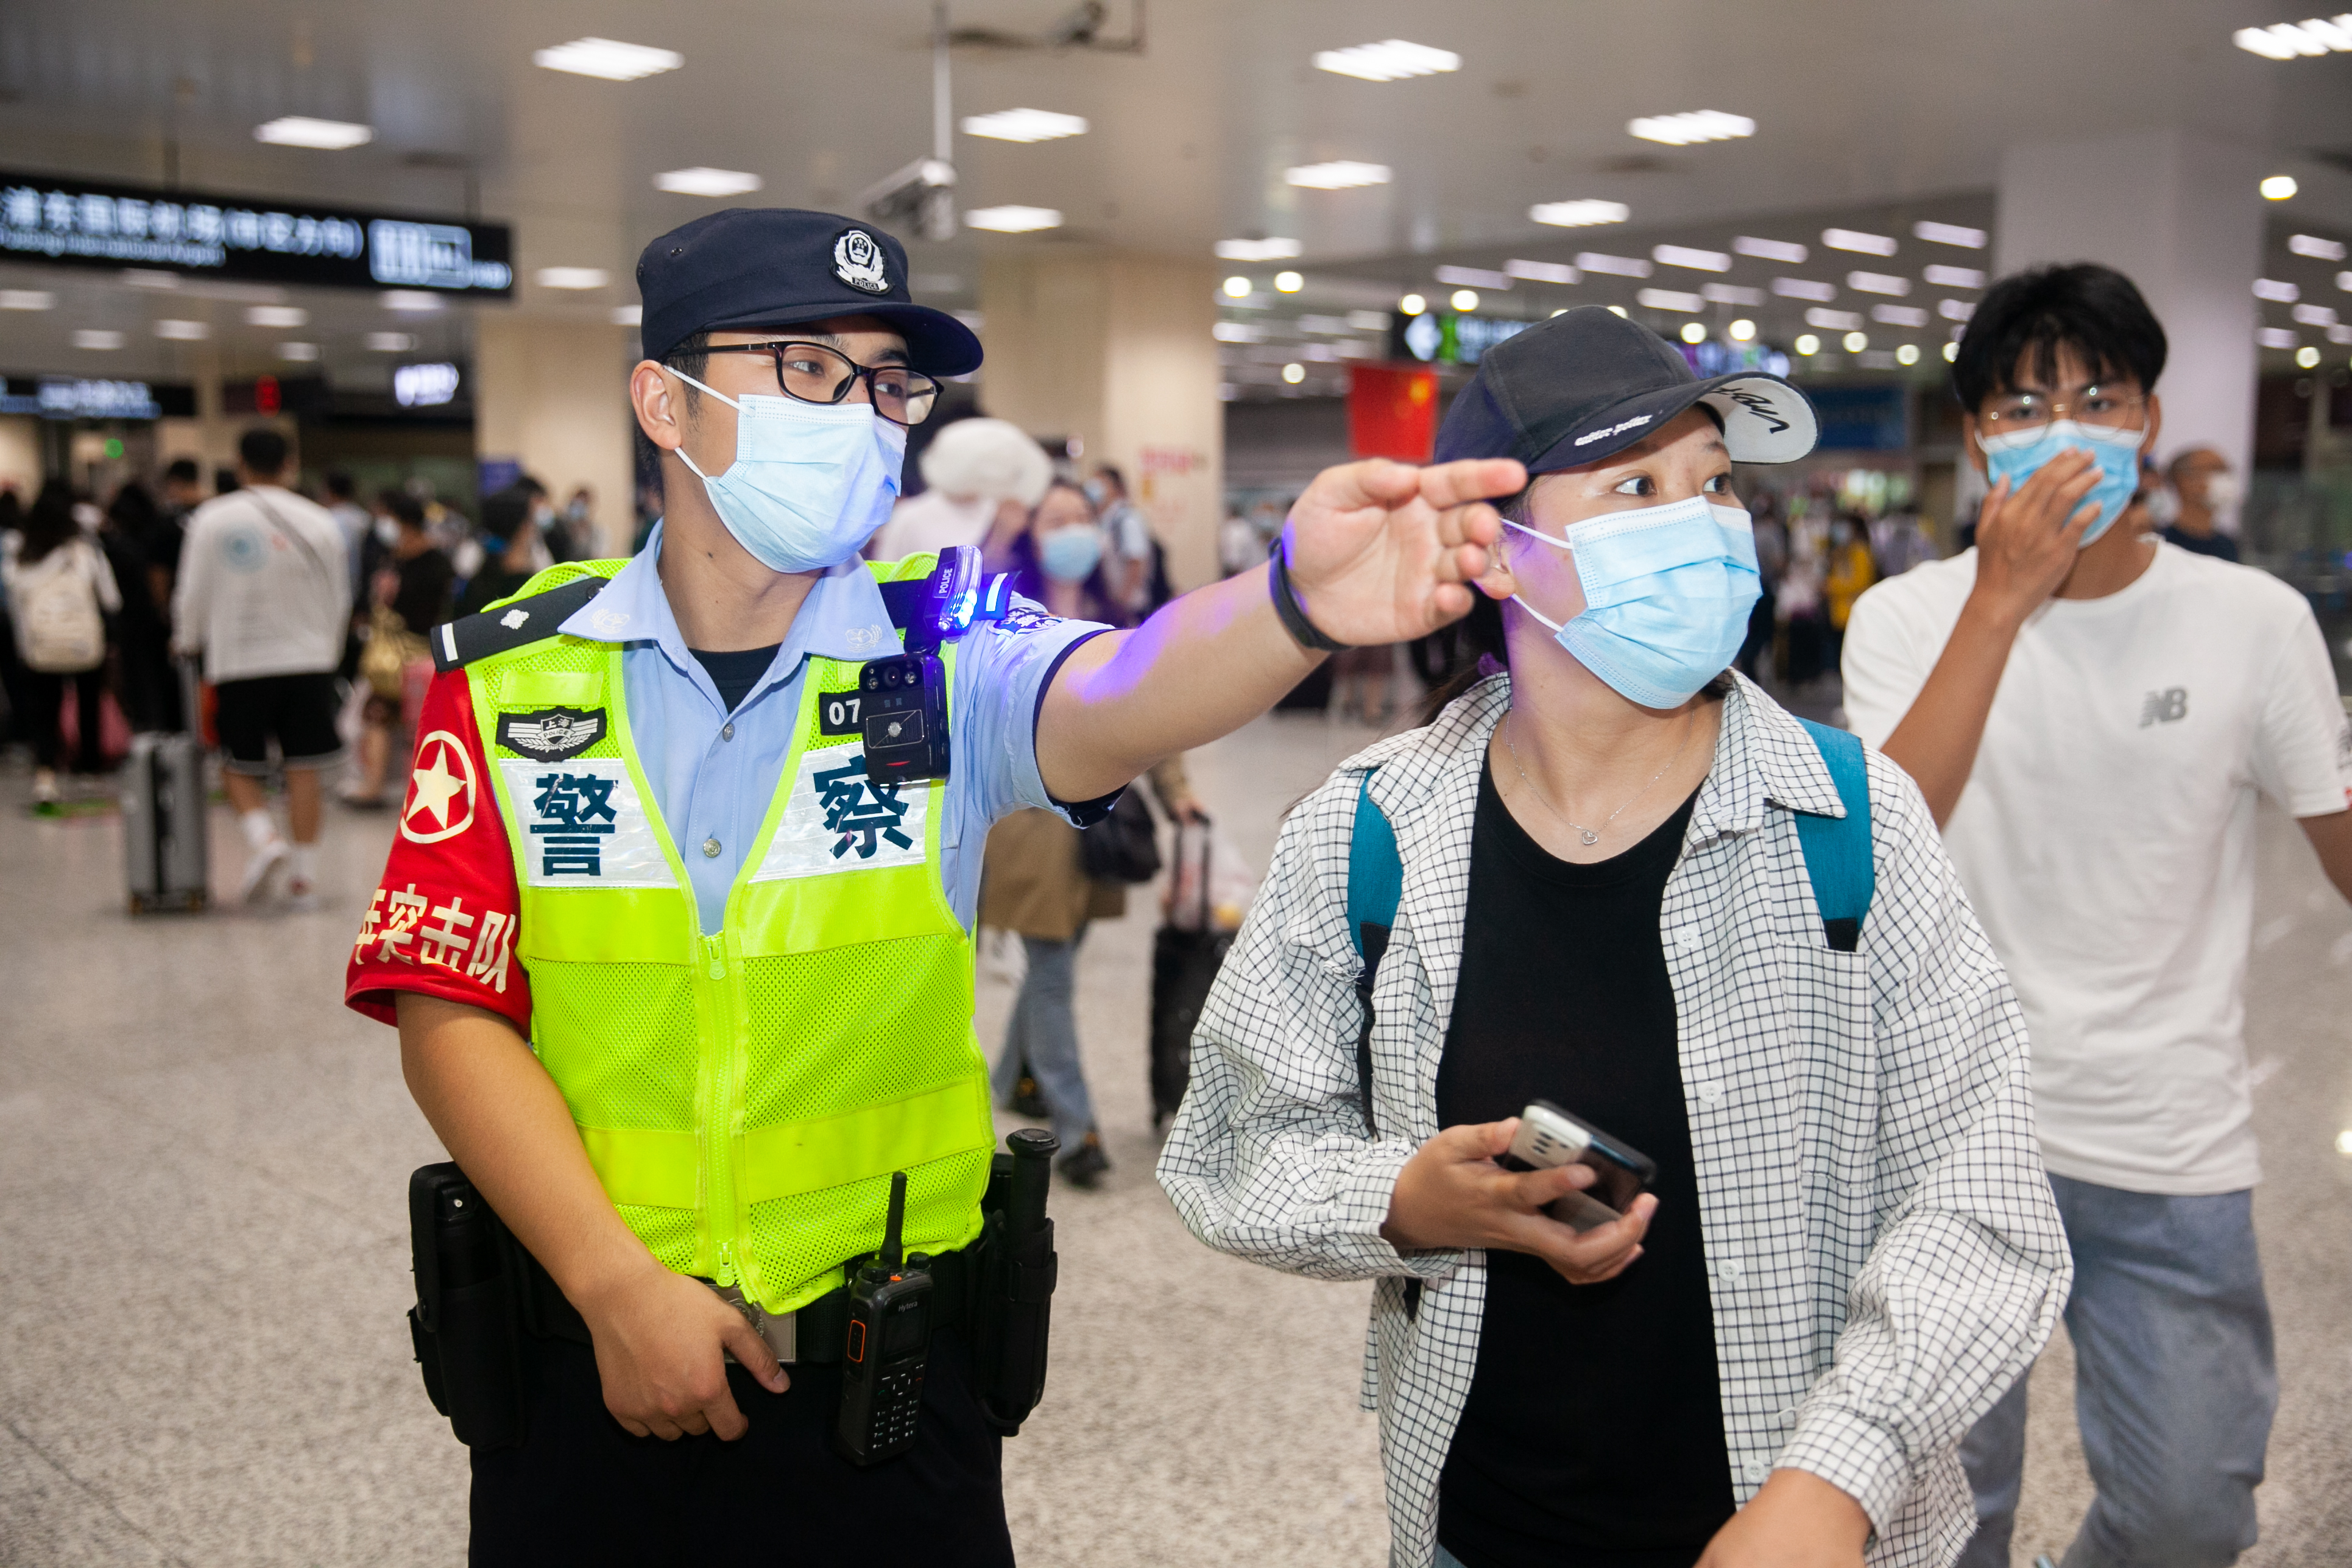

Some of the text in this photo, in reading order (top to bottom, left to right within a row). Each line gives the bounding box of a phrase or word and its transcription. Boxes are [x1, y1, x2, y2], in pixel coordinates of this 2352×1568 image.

[855, 278, 878, 289] POLICE
[939, 568, 953, 594] POLICE
[828, 698, 861, 726] 07
[2139, 686, 2188, 729] NB
[543, 729, 568, 738] POLICE
[546, 718, 570, 730] 上海
[813, 754, 914, 860] 察
[529, 773, 619, 876] 警
[899, 1301, 918, 1312] Hytera
